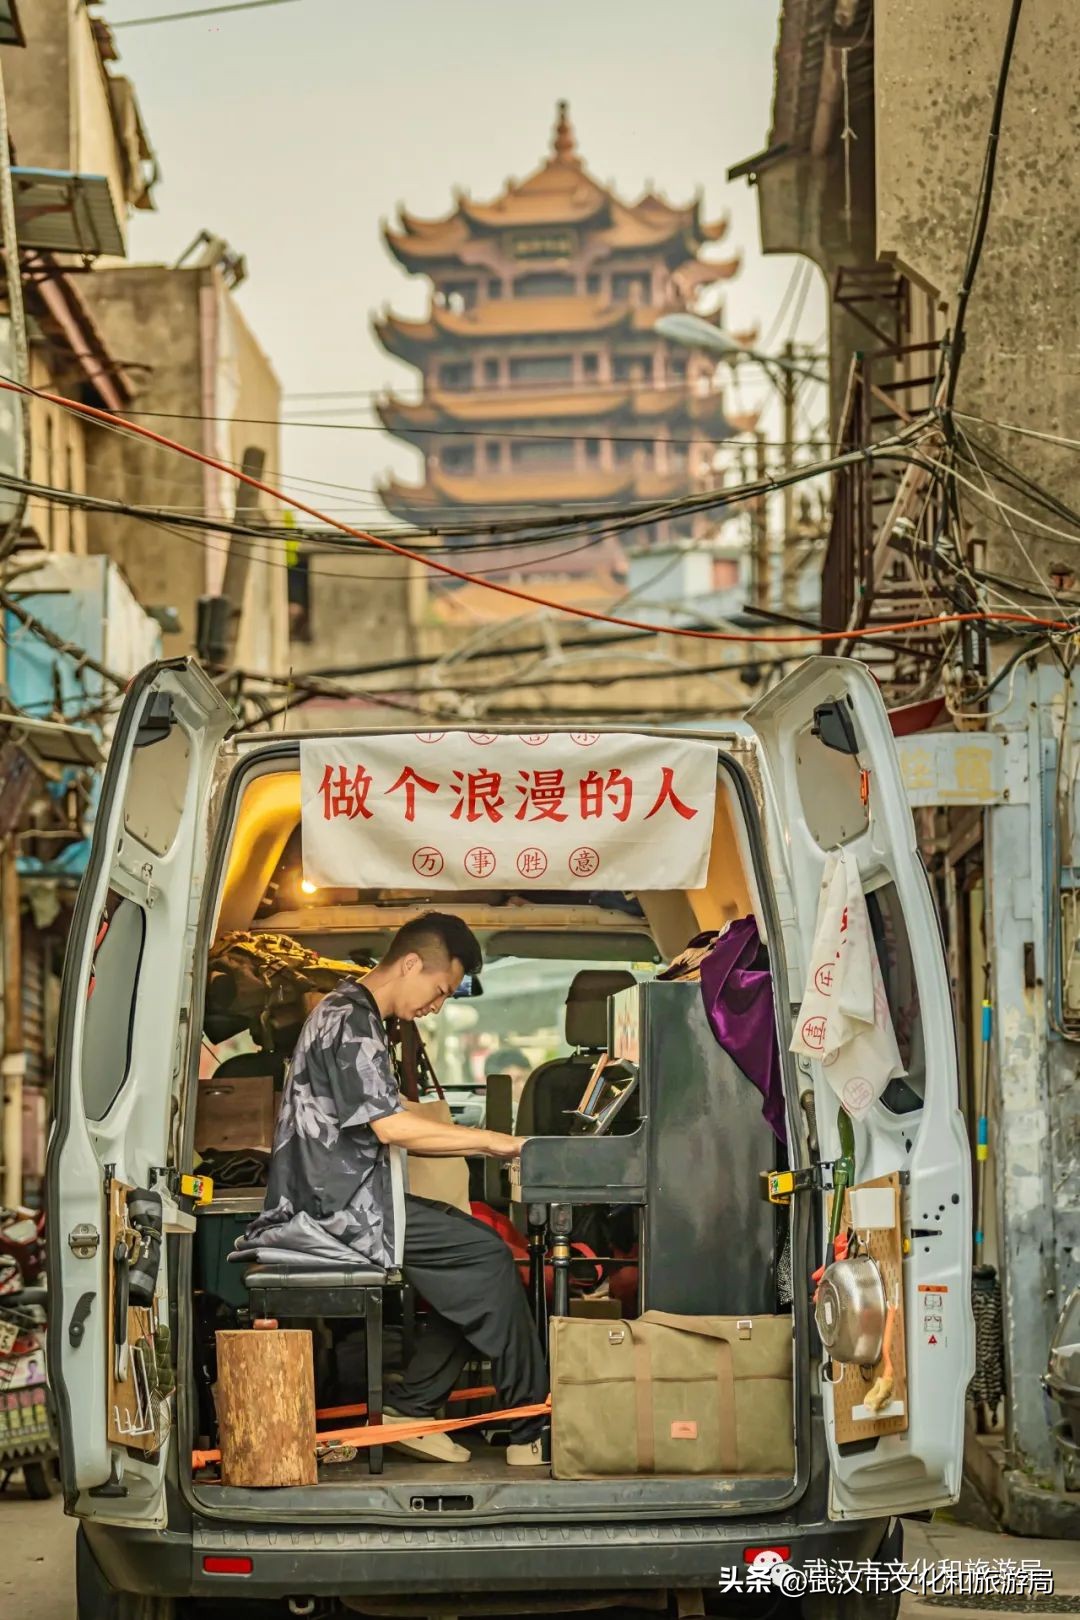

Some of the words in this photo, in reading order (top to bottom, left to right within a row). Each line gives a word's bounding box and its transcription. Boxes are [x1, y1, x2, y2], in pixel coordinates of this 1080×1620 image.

[317, 763, 699, 823] 做个浪漫的人
[414, 848, 598, 876] 万事胜意
